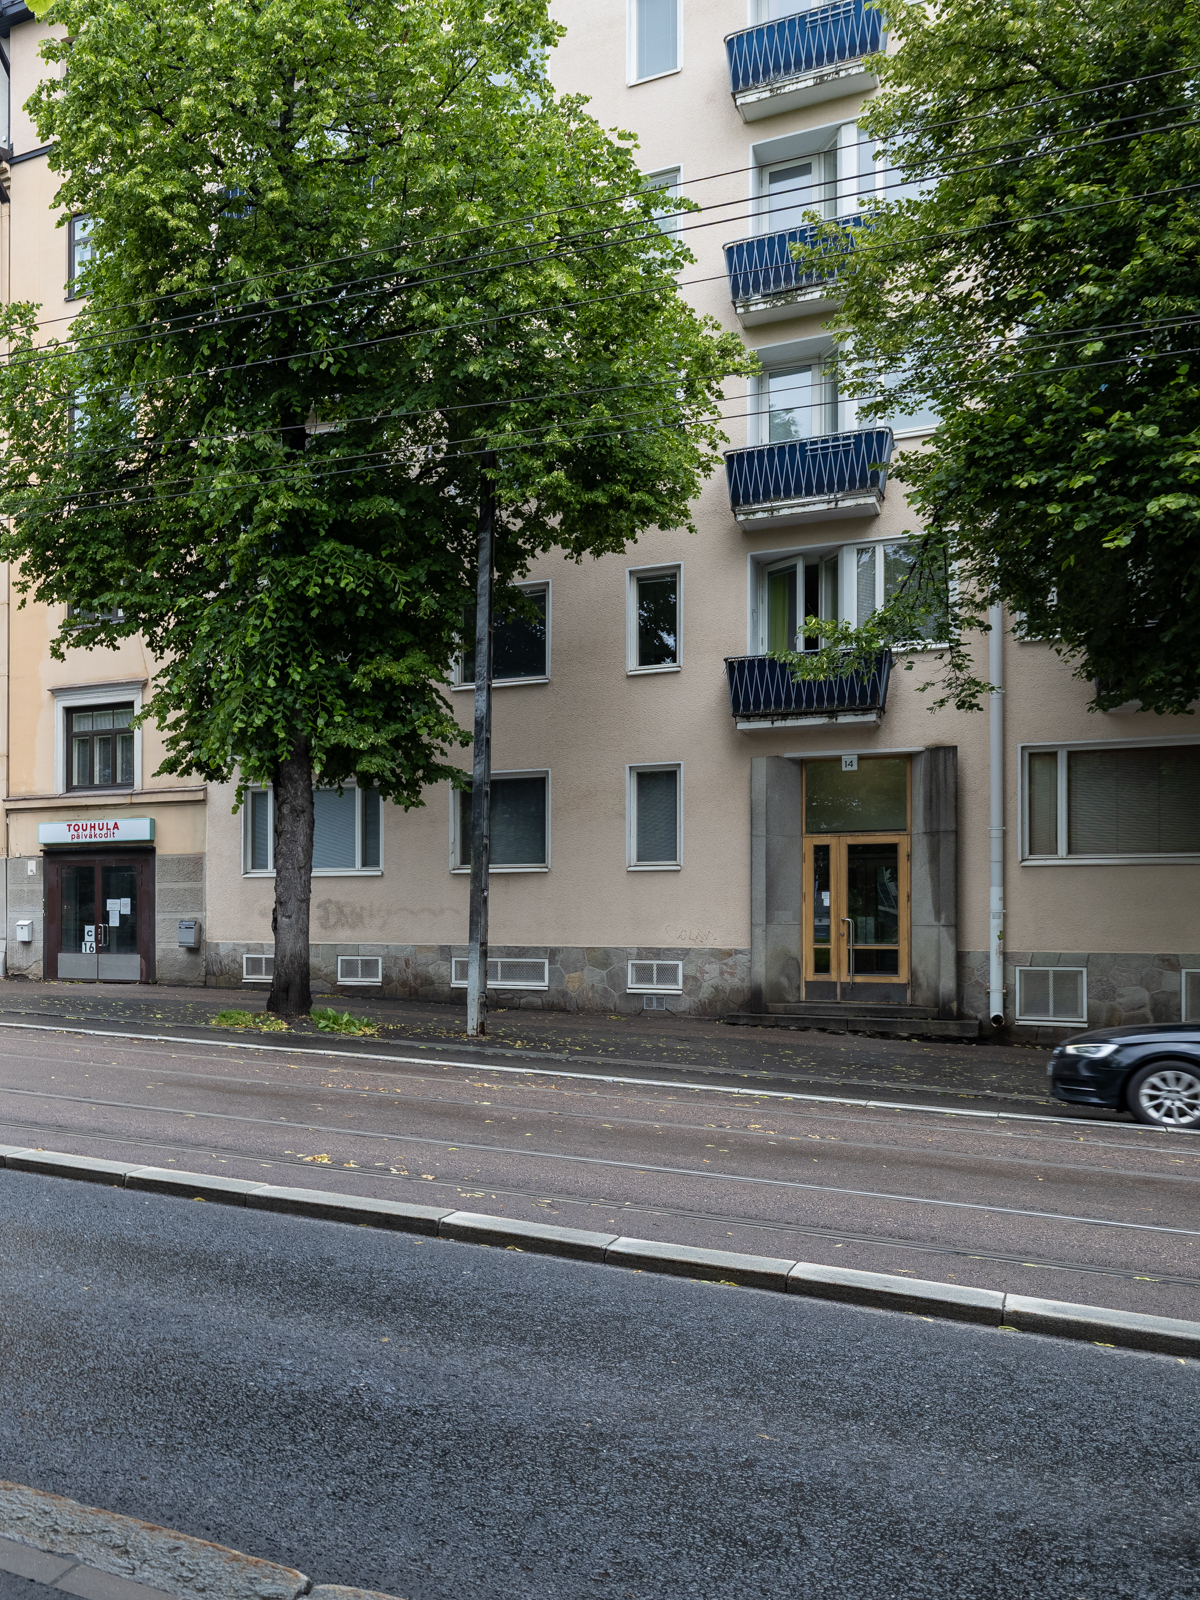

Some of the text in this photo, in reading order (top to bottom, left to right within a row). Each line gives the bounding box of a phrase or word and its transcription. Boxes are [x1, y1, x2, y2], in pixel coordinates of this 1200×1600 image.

[844, 760, 854, 769] 14
[66, 821, 120, 832] TOUHULA
[71, 830, 116, 841] päiväkodit
[83, 942, 95, 953] 16
